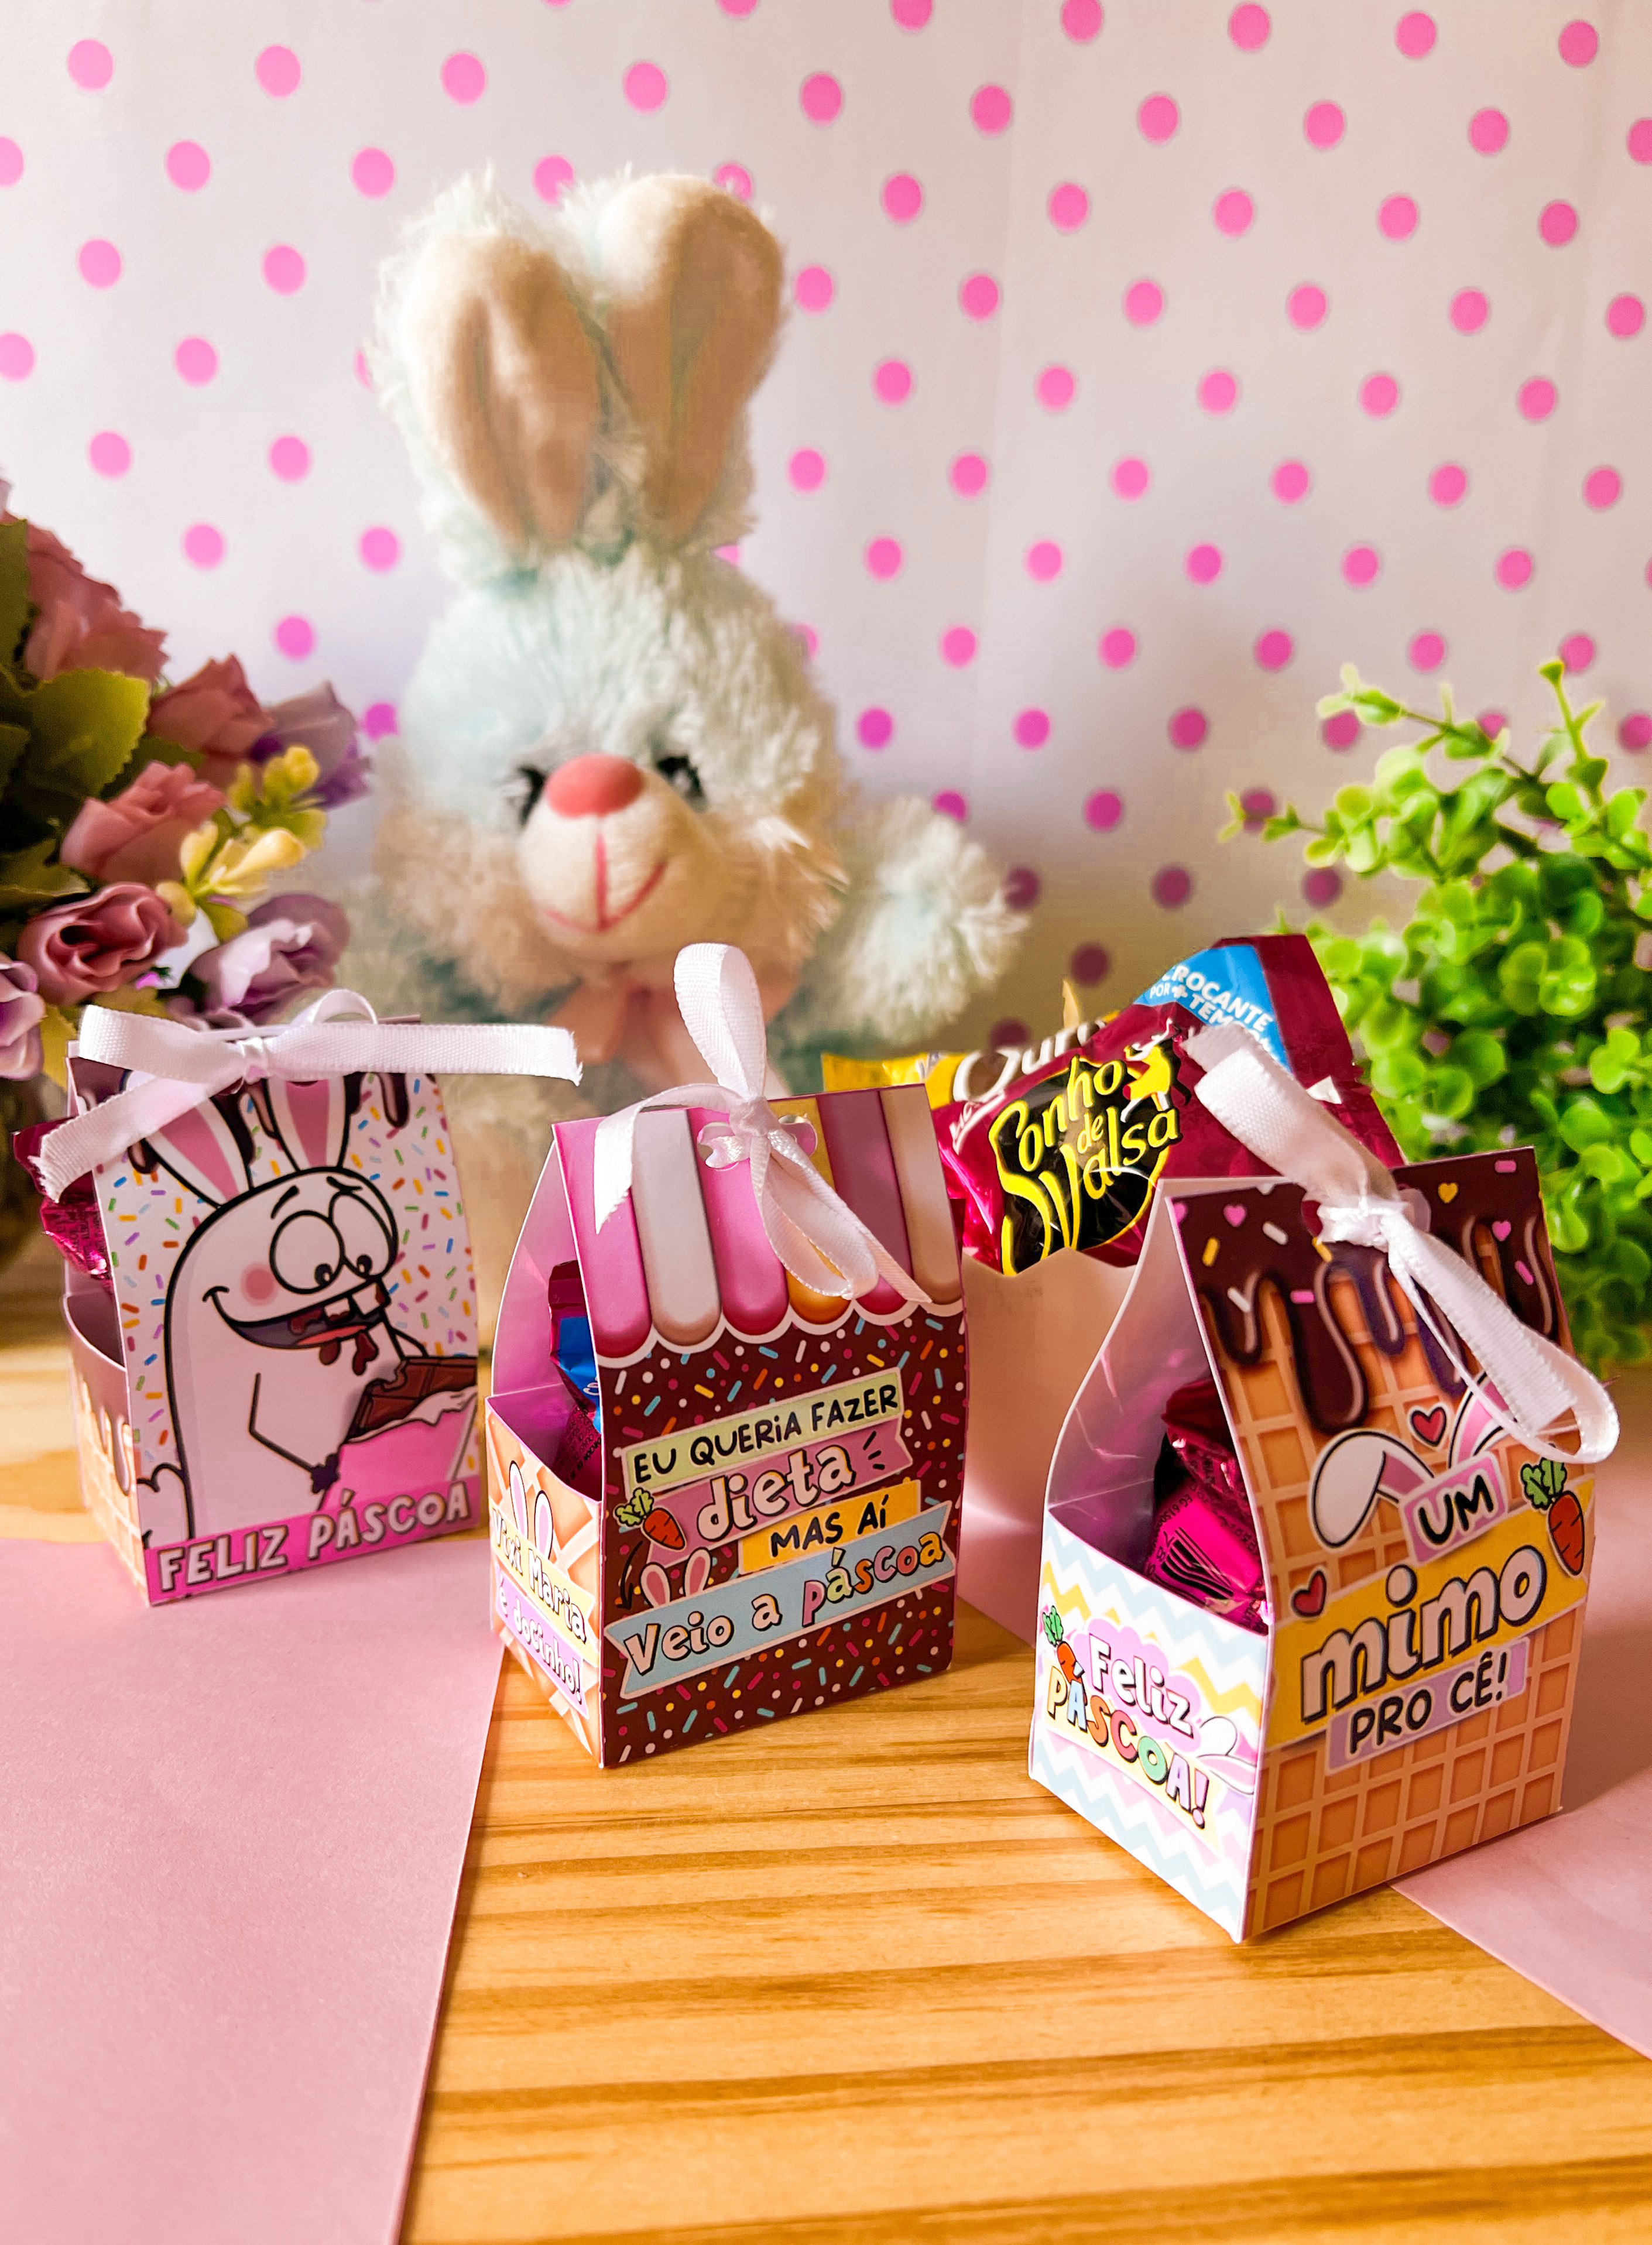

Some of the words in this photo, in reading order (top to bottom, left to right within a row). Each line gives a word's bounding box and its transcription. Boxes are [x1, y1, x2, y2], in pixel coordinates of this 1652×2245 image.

[1149, 983, 1170, 999] POR
[989, 1055, 1125, 1276] Sonho
[1038, 1106, 1179, 1250] Valsa
[1077, 1112, 1105, 1154] de
[634, 1448, 677, 1483] EU
[811, 1384, 898, 1431] FAZER
[157, 1525, 288, 1592] FELIZ
[307, 1480, 468, 1560] PÁSCOA
[697, 1444, 856, 1542] dieta
[771, 1511, 843, 1557] MAS
[1418, 1475, 1493, 1545] UM
[492, 1507, 523, 1576] Vixi
[528, 1548, 587, 1644] Maria
[624, 1611, 734, 1675] Veio
[752, 1593, 783, 1630] a
[801, 1531, 945, 1627] páscoa
[499, 1569, 508, 1618] é
[513, 1596, 582, 1705] docinho!
[1089, 1633, 1194, 1739] Feliz
[1300, 1545, 1547, 1725] mimo
[1047, 1661, 1209, 1829] PÁSCOA!
[1349, 1689, 1432, 1754] PRO
[1450, 1651, 1507, 1713] CÊ!
